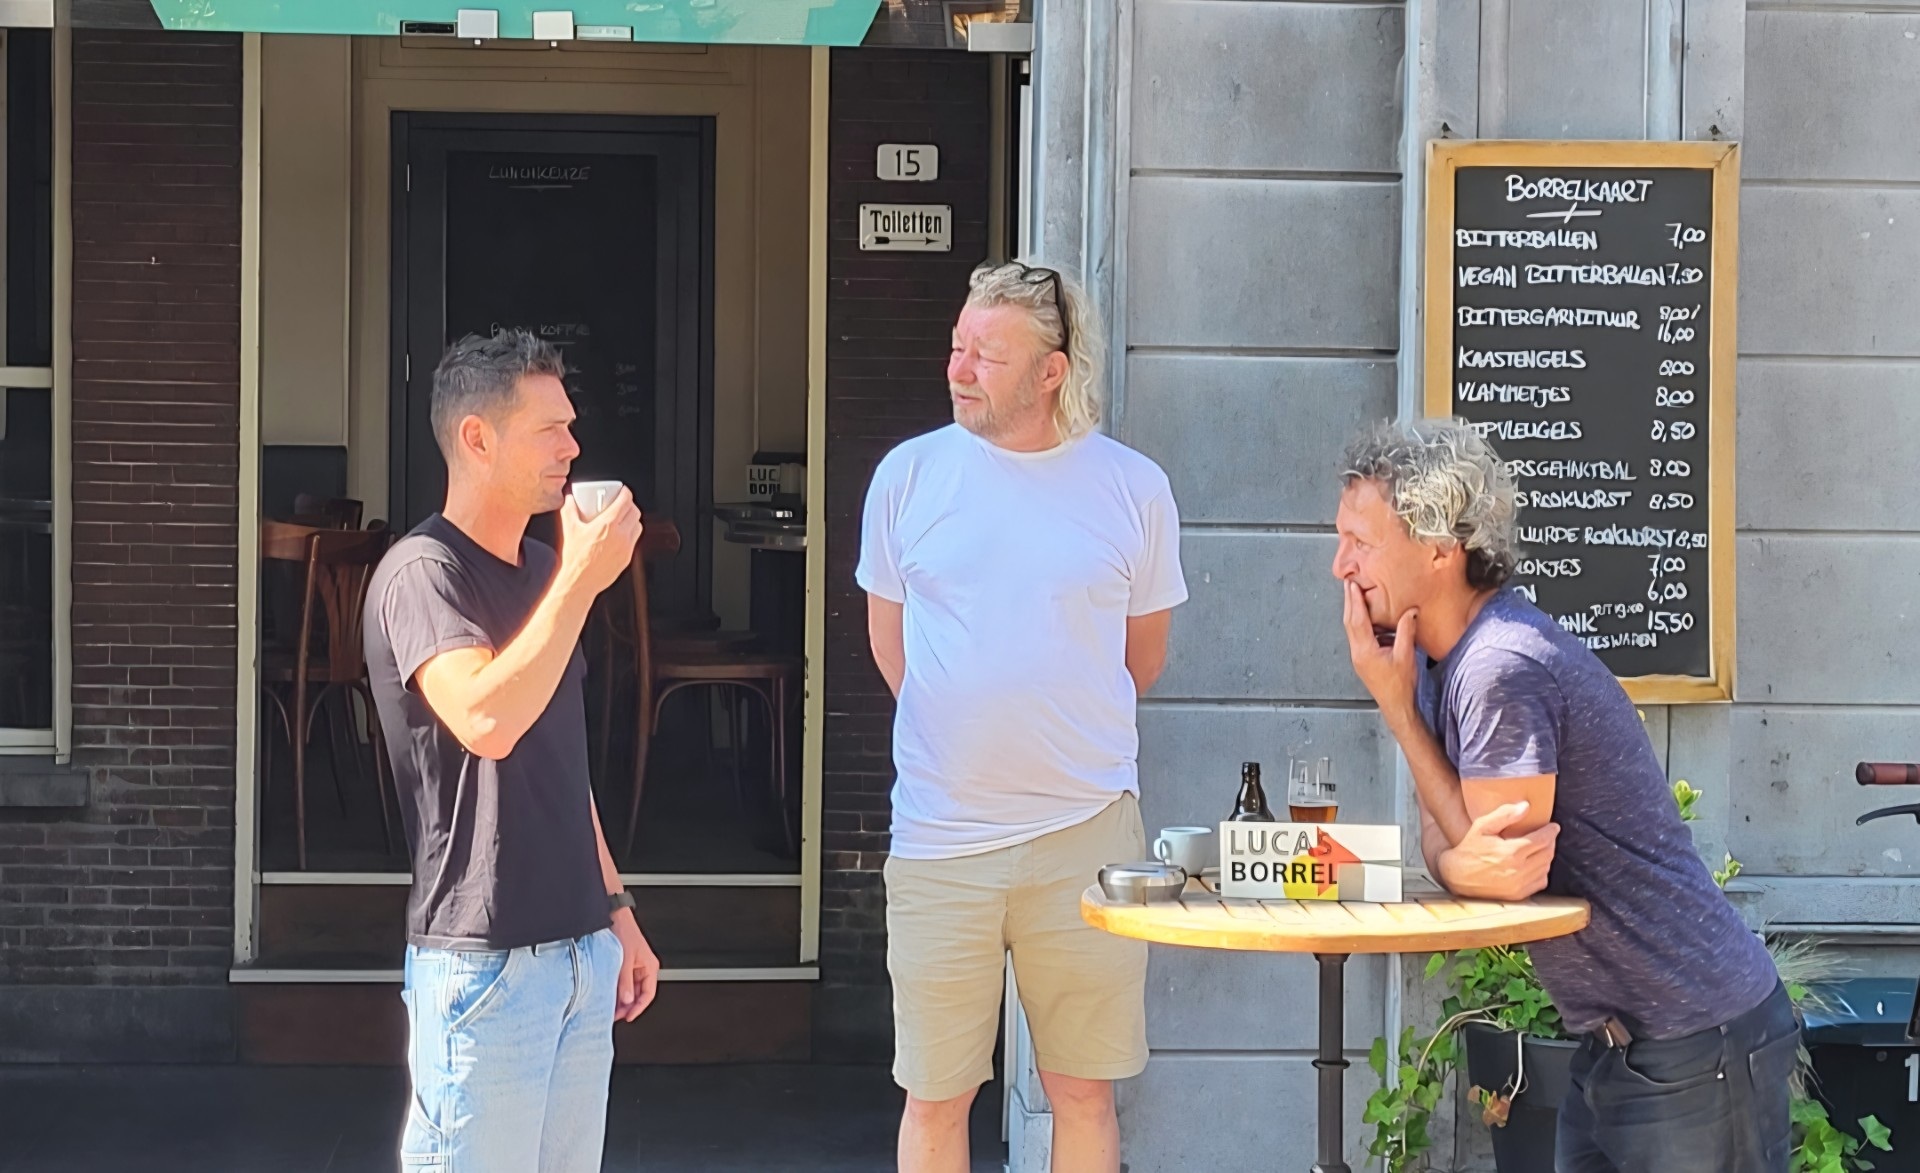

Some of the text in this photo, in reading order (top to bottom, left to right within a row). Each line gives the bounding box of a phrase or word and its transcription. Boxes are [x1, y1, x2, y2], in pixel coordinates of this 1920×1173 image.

[896, 150, 920, 176] 15
[1504, 175, 1653, 202] BORRELKAART
[870, 210, 942, 234] Toiletten
[1456, 222, 1706, 250] BITTERBALLEN 7,00
[1458, 265, 1517, 288] VEGAN
[1525, 264, 1666, 286] BITTERBALLEN
[1458, 307, 1641, 330] BITTERGARNITUUR
[1458, 345, 1587, 369] KAASTENGELS
[1458, 381, 1571, 408] VLAMMETJES
[1651, 420, 1696, 443] 8,50
[749, 468, 777, 481] LUC
[1530, 489, 1632, 509] ROOKWORST
[1647, 554, 1686, 578] 7,00
[1647, 578, 1688, 604] 6,00
[1647, 609, 1694, 635] 15,50
[1231, 830, 1333, 856] LUCAS
[1231, 861, 1338, 885] BORREL
